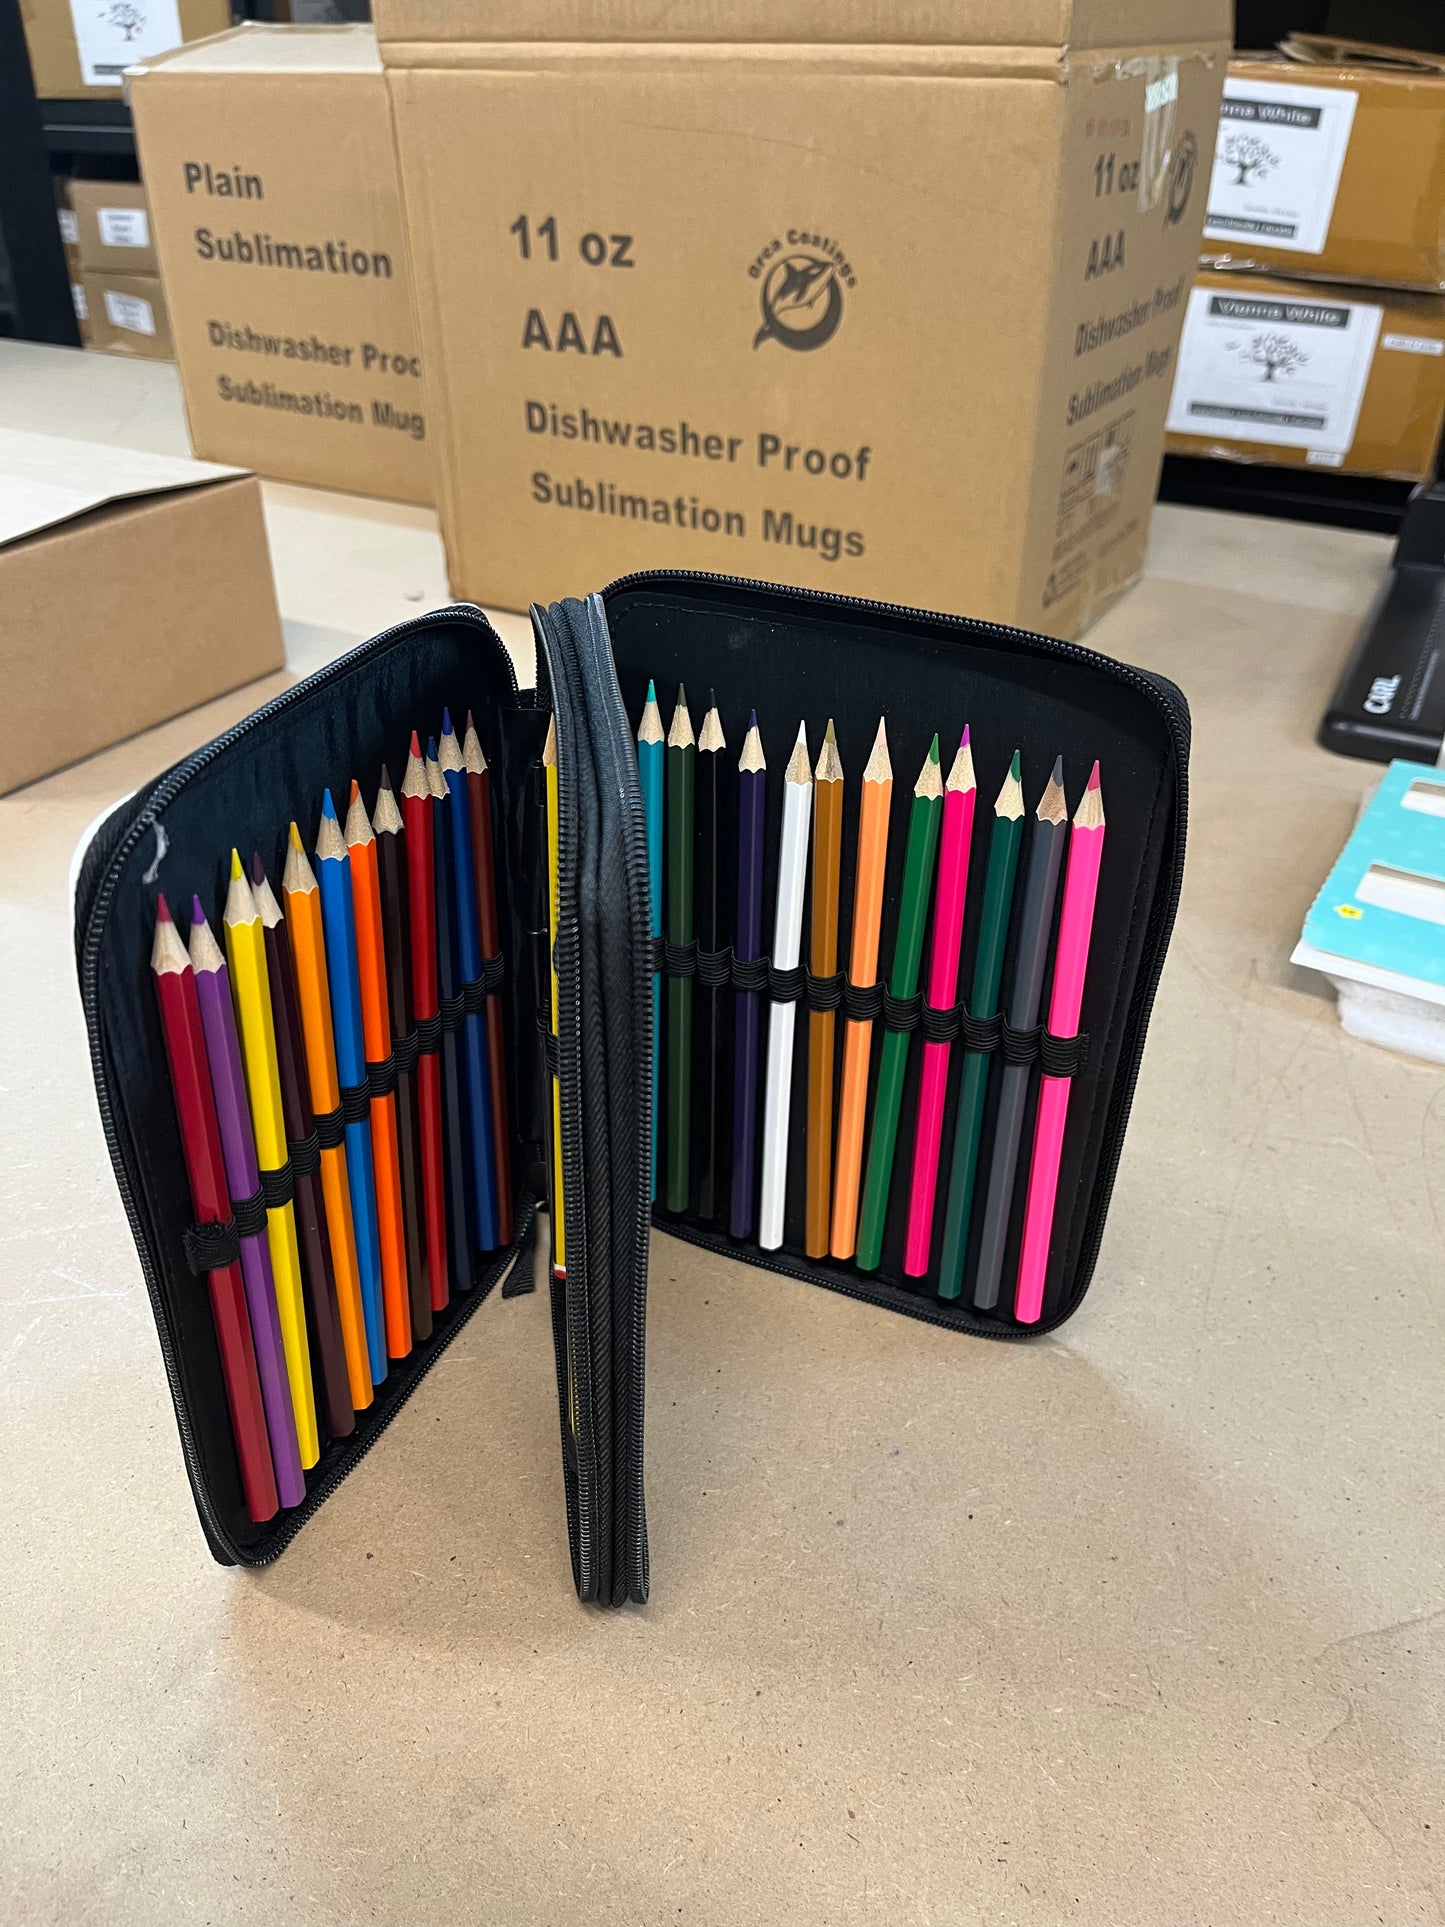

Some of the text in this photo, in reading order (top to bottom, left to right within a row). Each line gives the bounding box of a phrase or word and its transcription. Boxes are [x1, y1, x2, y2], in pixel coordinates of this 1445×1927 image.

[184, 162, 264, 200] Plain
[1094, 152, 1116, 197] 11
[195, 228, 393, 279] Sublimation
[510, 213, 635, 268] 11 oz
[786, 229, 857, 288] Coatings
[1084, 231, 1125, 282] AAA
[208, 319, 421, 379] Dishwasher Proo
[522, 308, 624, 358] AAA
[217, 372, 425, 442] Sublimation Mug
[525, 399, 872, 482] Dishwasher Proof
[531, 471, 865, 562] Sublimation Mugs
